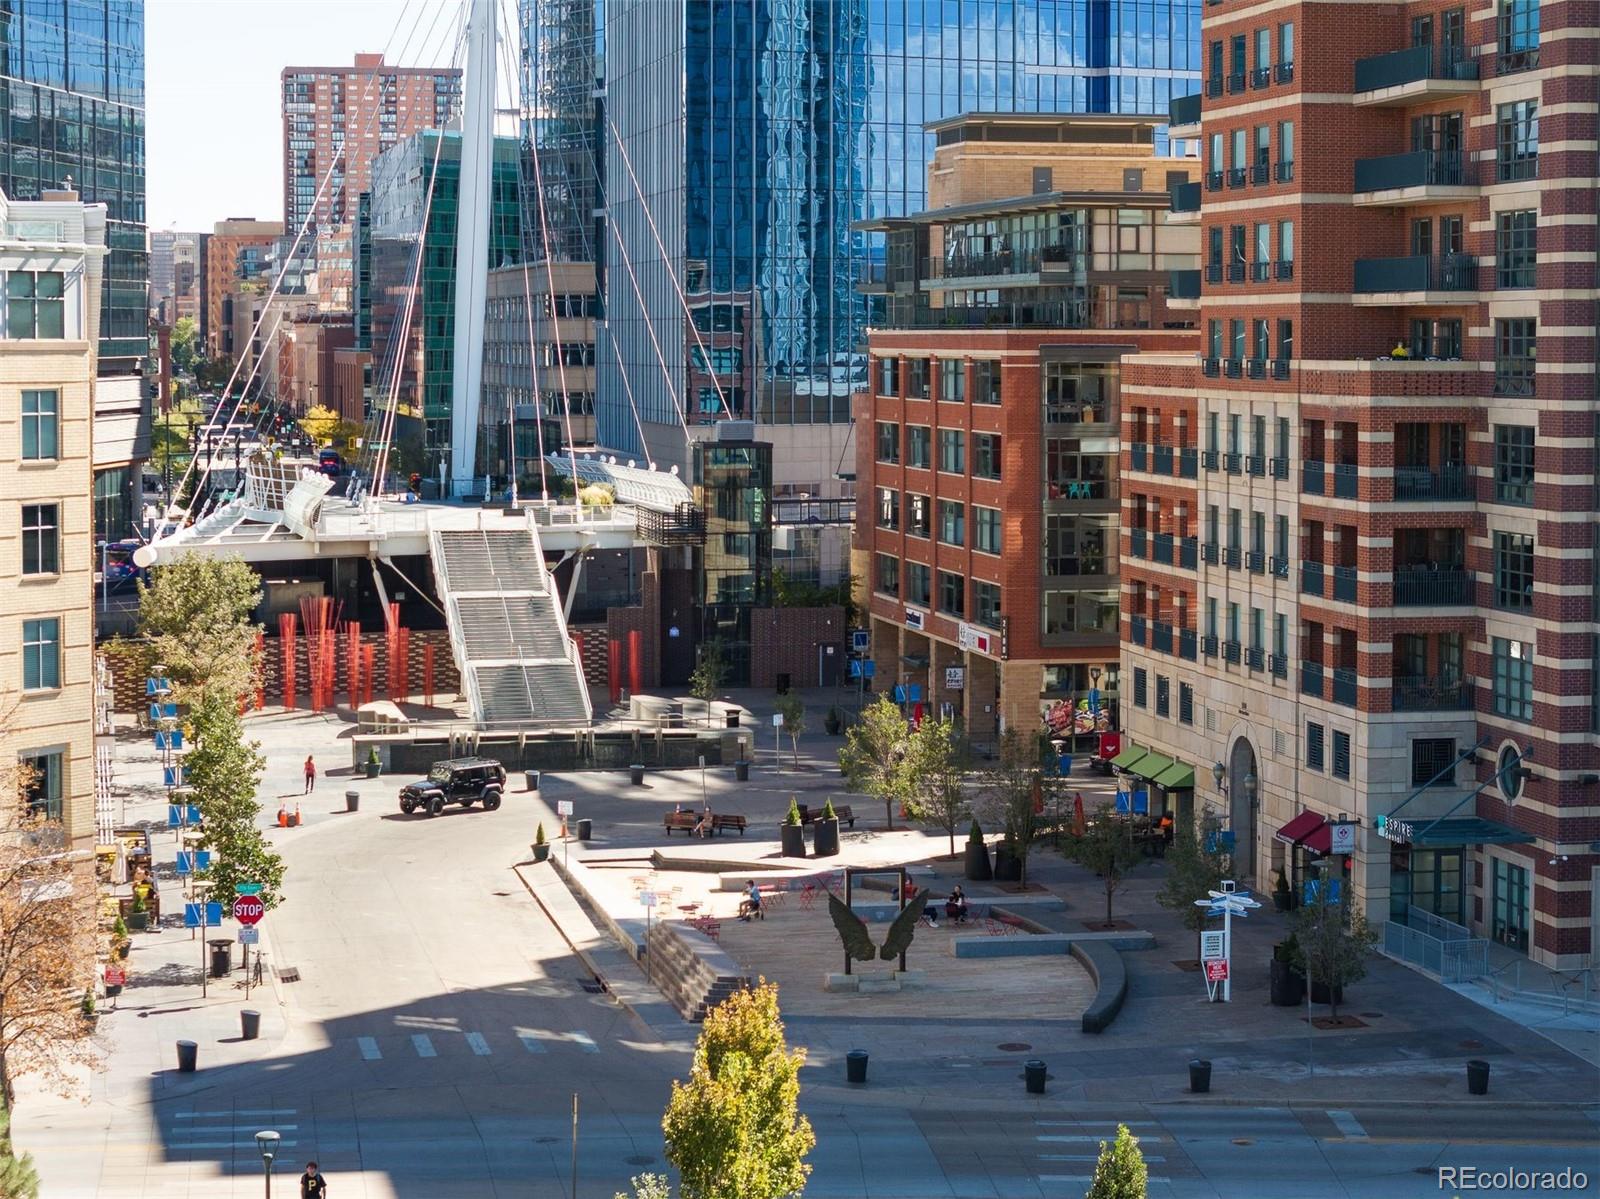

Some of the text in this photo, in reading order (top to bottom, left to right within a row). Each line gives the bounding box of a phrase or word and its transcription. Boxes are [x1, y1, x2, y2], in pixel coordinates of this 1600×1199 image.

[1385, 816, 1413, 837] ESPIRE
[235, 904, 263, 916] STOP
[308, 1179, 317, 1191] P
